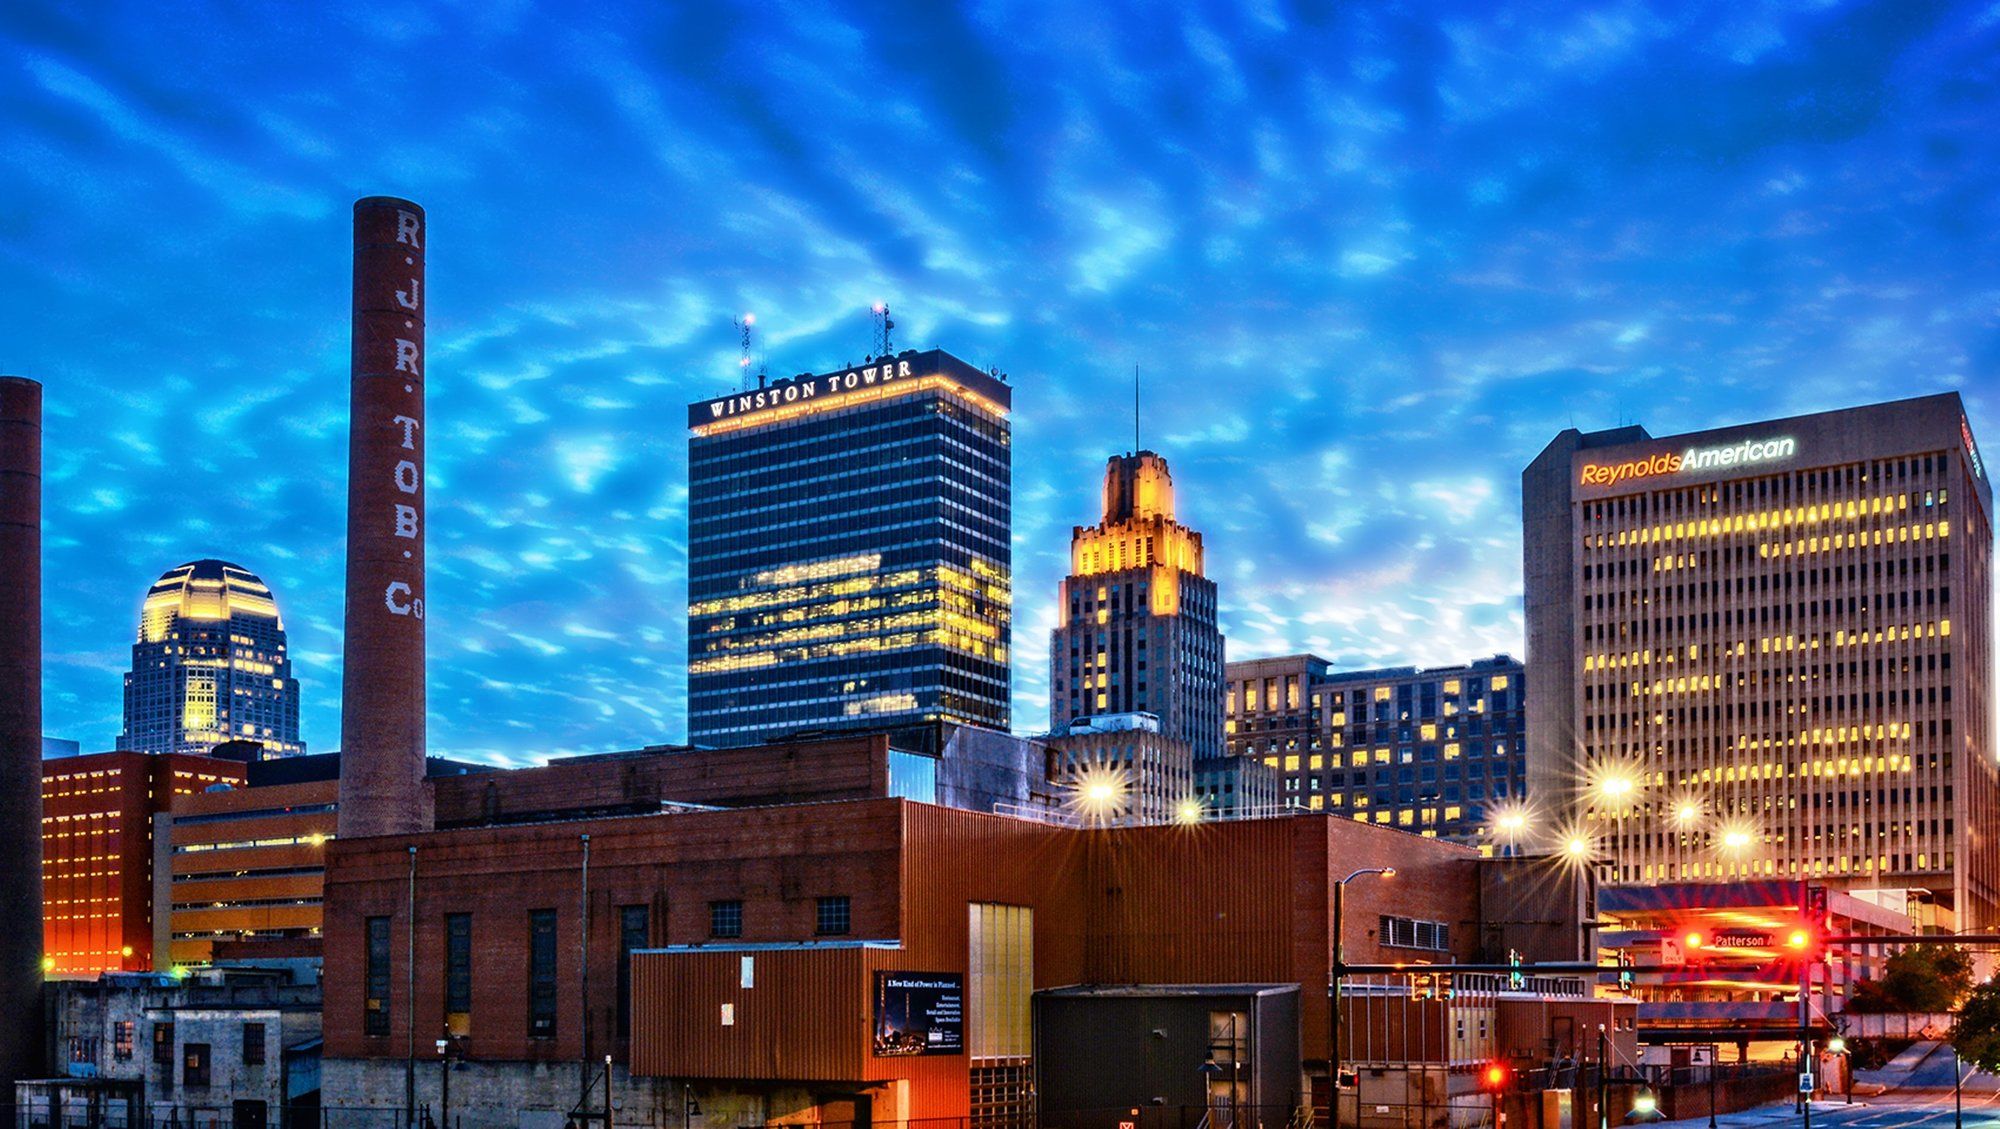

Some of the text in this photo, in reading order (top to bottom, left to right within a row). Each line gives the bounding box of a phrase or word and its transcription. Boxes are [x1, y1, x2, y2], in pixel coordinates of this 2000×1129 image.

[710, 360, 912, 418] WINSTON TOWER
[1715, 935, 1764, 947] Patterson
